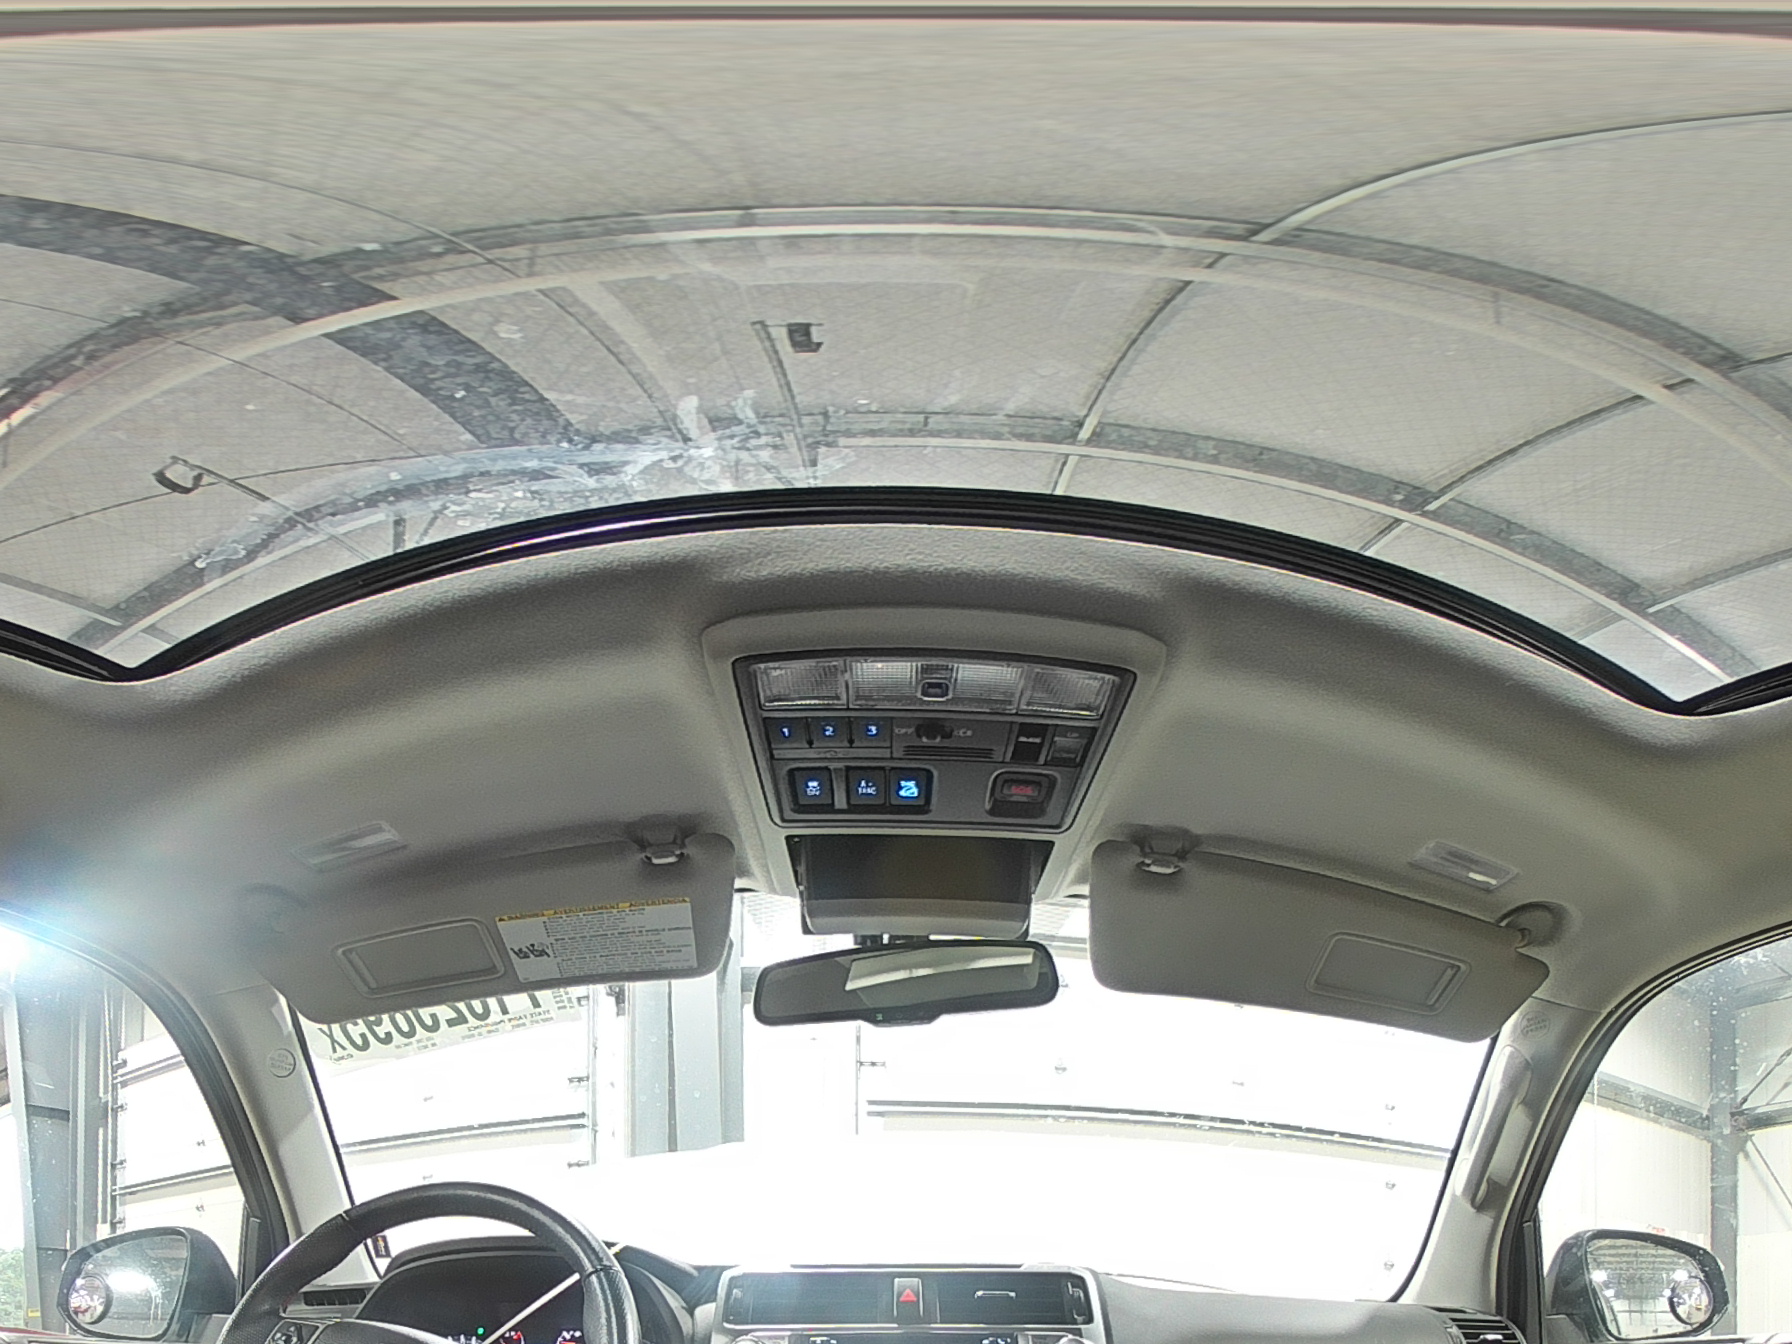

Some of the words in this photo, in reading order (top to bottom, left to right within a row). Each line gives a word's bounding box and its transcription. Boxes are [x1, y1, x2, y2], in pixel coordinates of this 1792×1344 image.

[782, 728, 789, 737] 1
[824, 726, 834, 736] 2
[867, 726, 877, 735] 3
